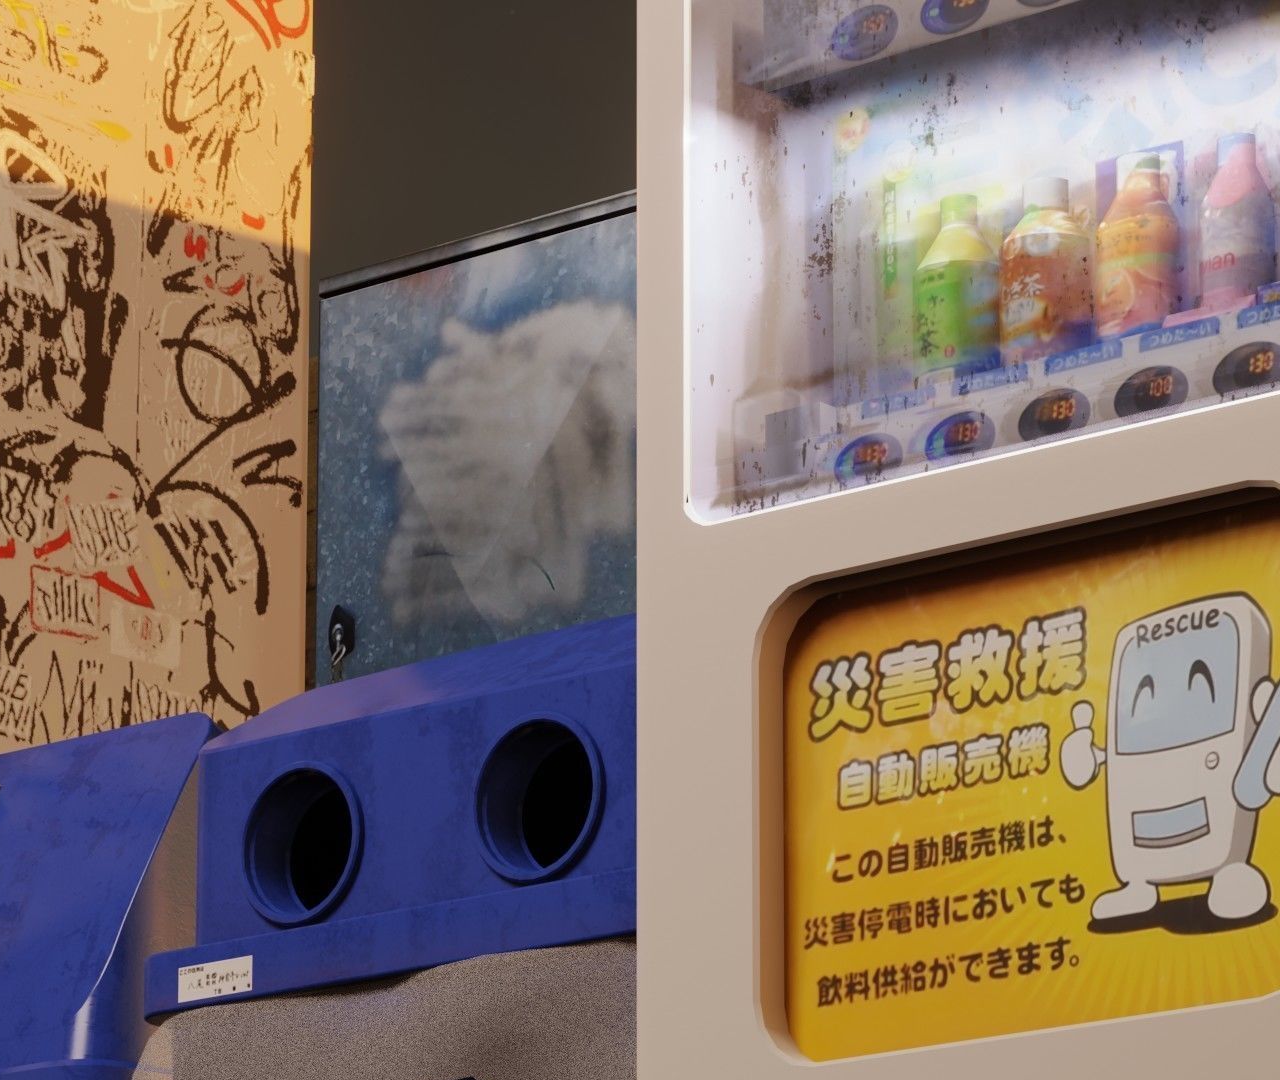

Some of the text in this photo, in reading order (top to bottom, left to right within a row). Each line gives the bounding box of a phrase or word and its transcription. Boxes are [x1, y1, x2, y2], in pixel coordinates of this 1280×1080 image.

[1199, 251, 1236, 275] vian
[1249, 351, 1274, 375] 130
[1051, 398, 1075, 420] 130
[1135, 606, 1222, 649] Rescue
[808, 606, 1088, 743] 災害救援
[836, 723, 1052, 810] 自動販売機
[830, 816, 1069, 882] この自動販売機は、
[803, 873, 1087, 950] 災害停電時においても
[816, 934, 1082, 1008] 飲料供給ができます。
